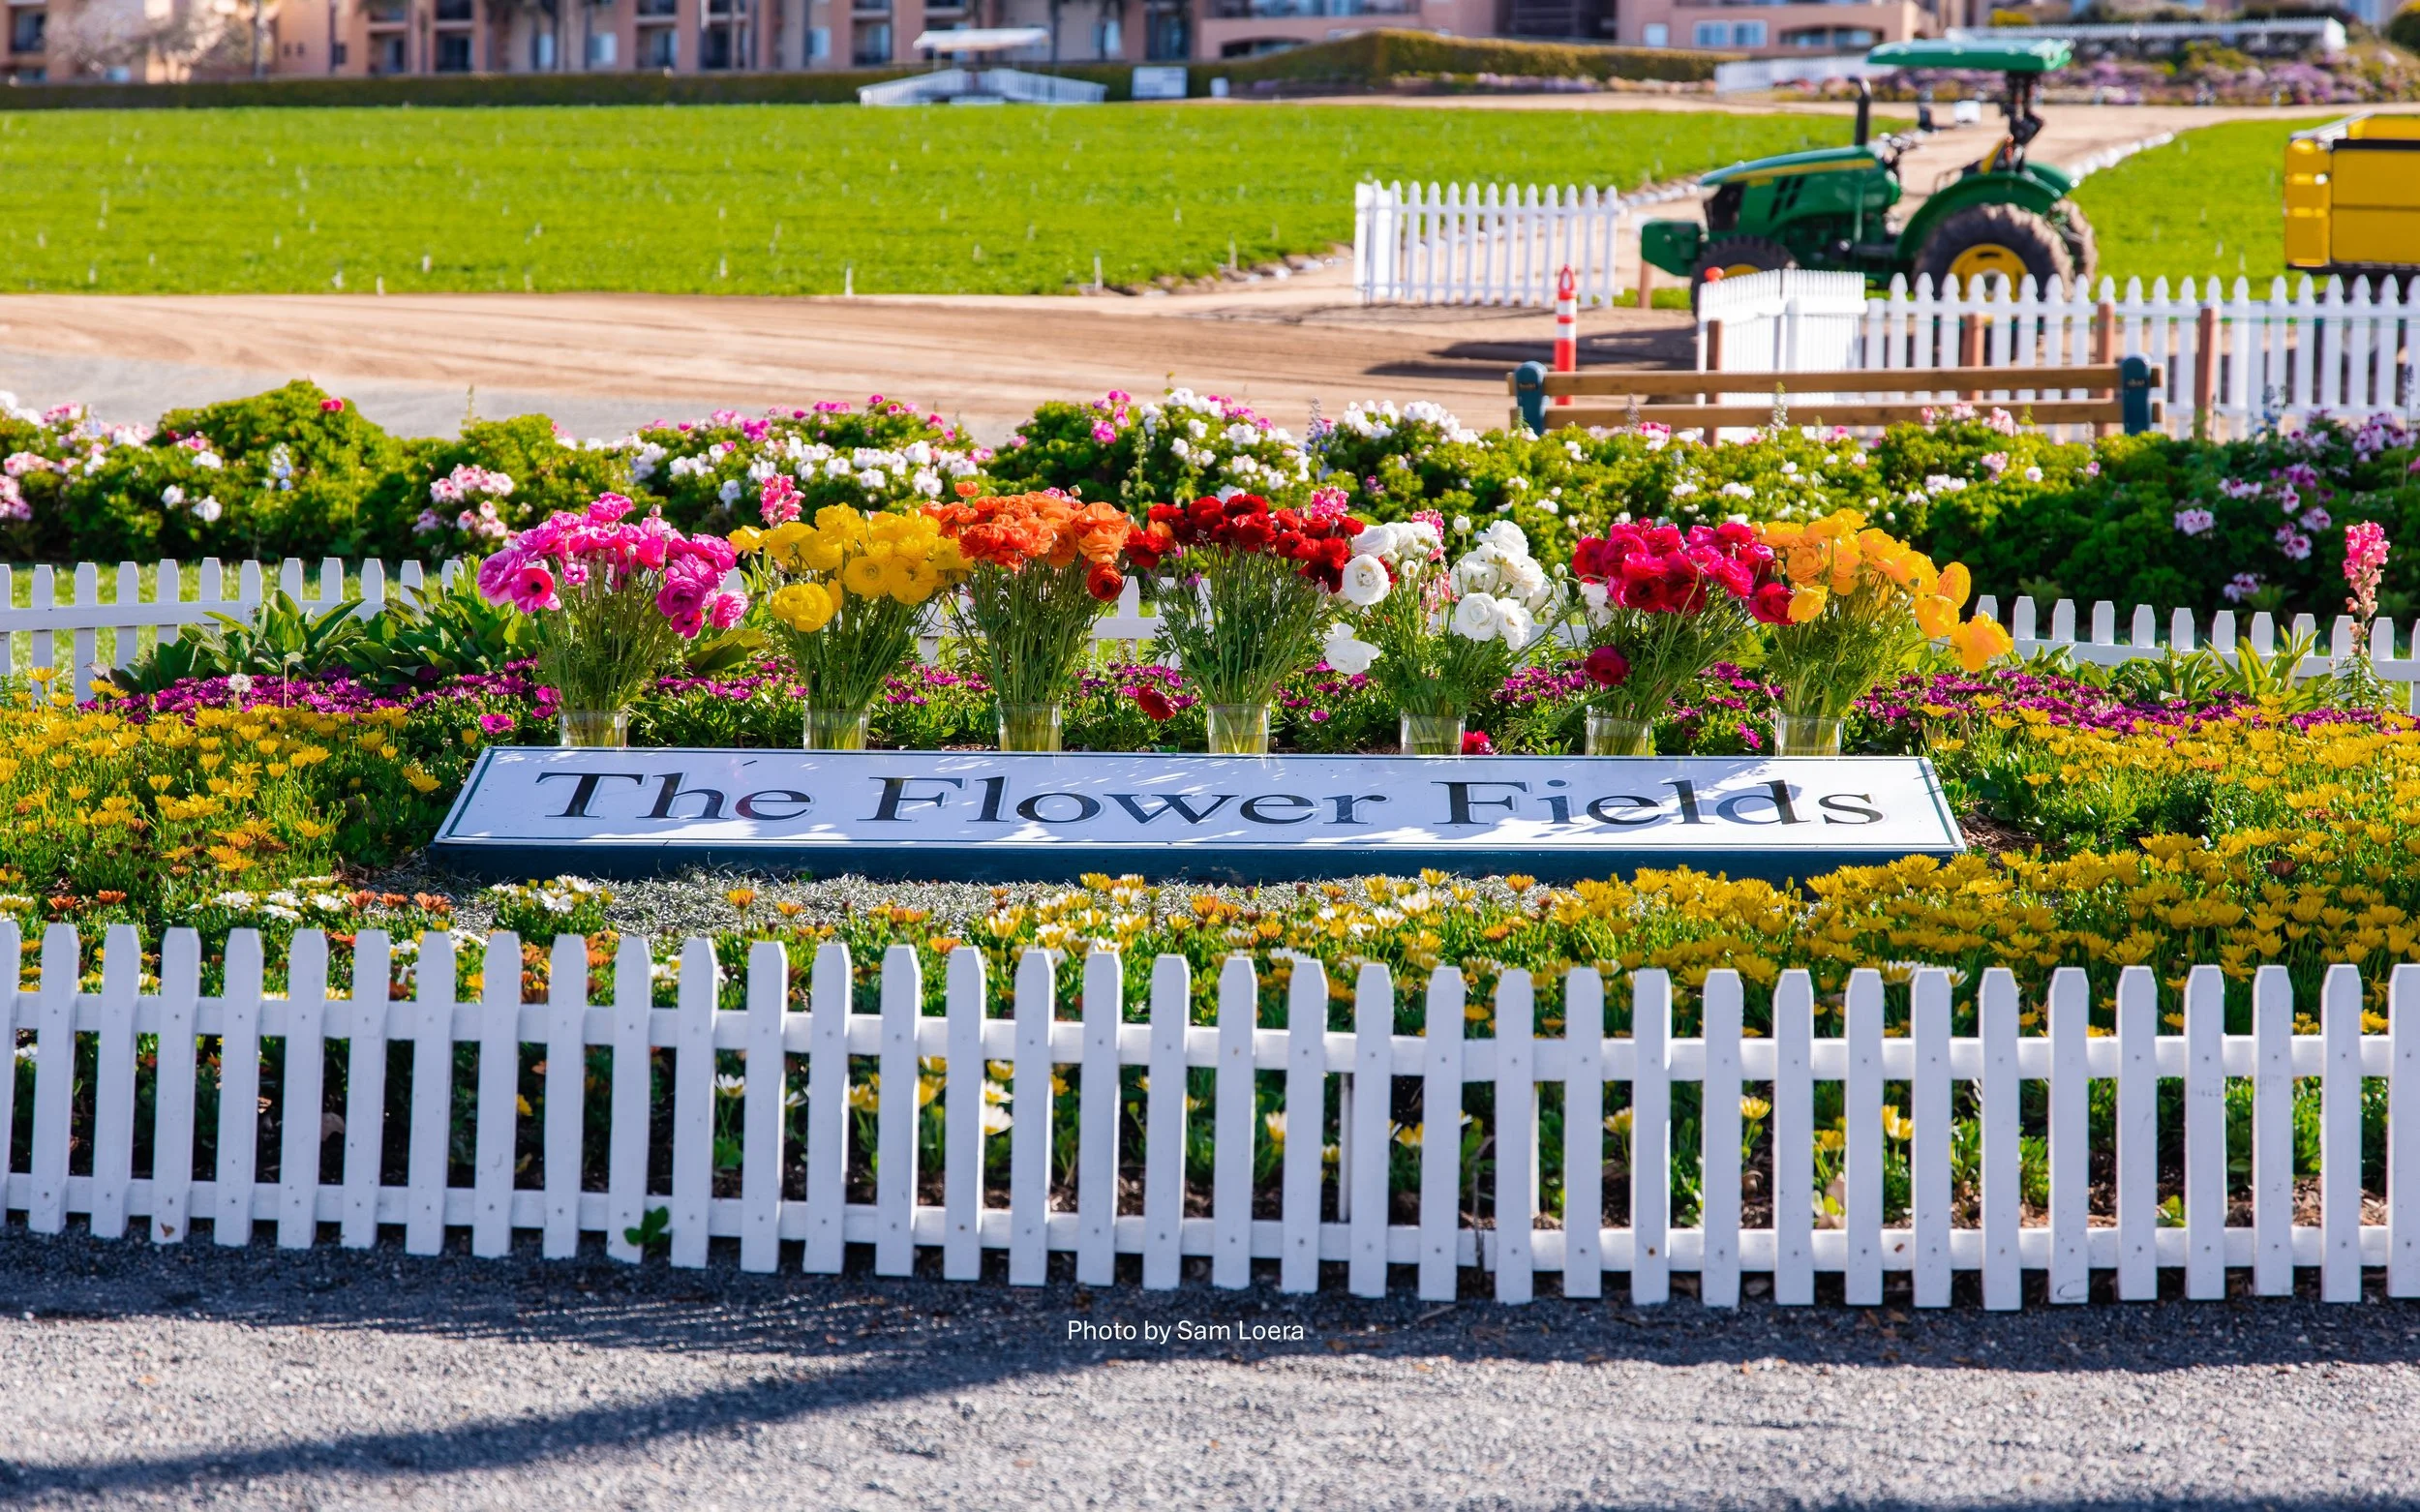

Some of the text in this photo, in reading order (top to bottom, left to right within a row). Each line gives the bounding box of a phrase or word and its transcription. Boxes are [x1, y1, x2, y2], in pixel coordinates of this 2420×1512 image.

[535, 771, 1884, 826] The Flower Fields
